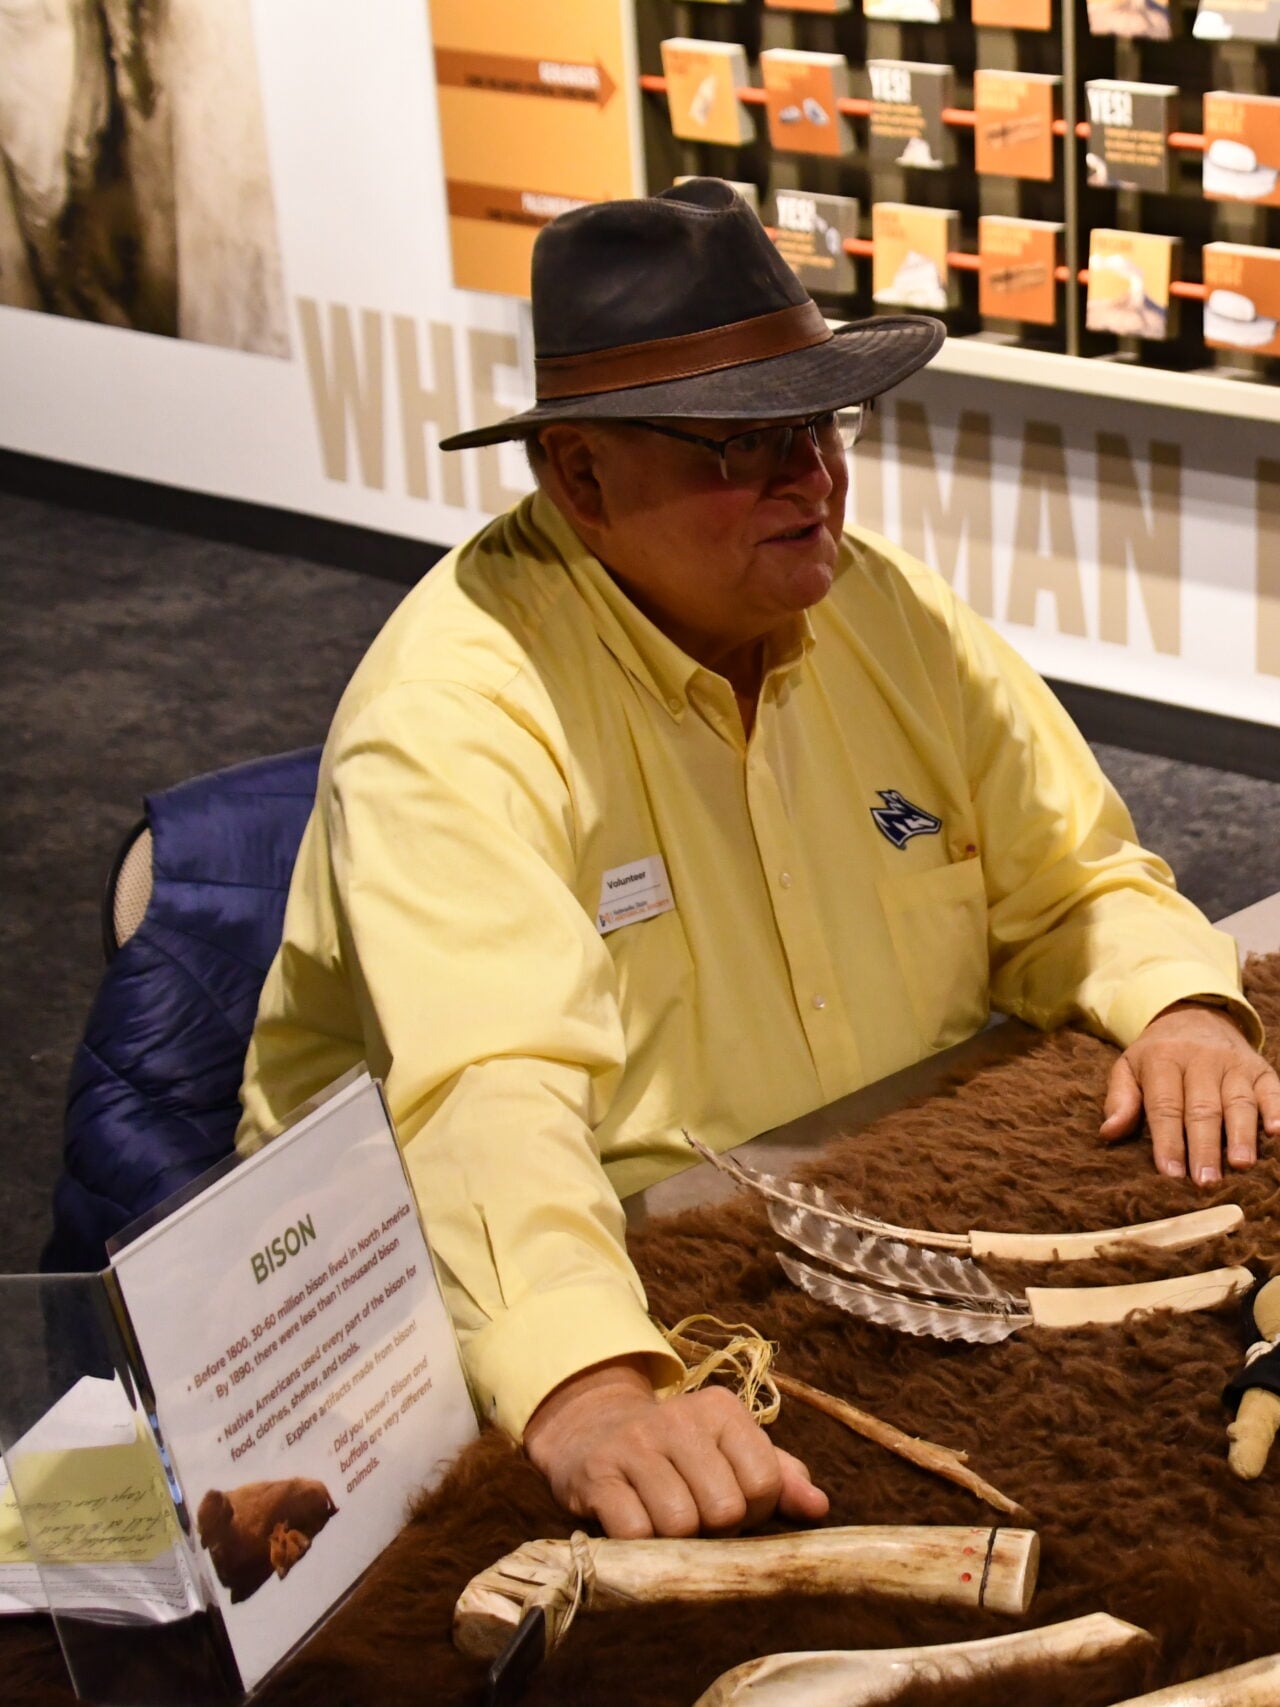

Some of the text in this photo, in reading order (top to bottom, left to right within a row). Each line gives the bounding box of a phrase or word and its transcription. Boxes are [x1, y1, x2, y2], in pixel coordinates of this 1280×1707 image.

[1087, 88, 1133, 127] YES!
[606, 871, 646, 889] Volunteer
[194, 1203, 410, 1388] Before 1800, 30-60 million bison lived in North America
[251, 1213, 316, 1284] BISON
[215, 1382, 229, 1398] By
[229, 1361, 255, 1386] 1890,
[254, 1341, 278, 1366] there
[278, 1321, 300, 1344] were
[299, 1307, 317, 1326] less
[317, 1291, 336, 1312] than
[341, 1252, 378, 1292] thousand
[377, 1237, 400, 1261] bison
[224, 1264, 417, 1439] Native Americans used every part of the bison for
[230, 1342, 361, 1462] food, clothes, shelter, and tools.
[286, 1319, 418, 1447] Explore artifacts made from bison!
[334, 1354, 428, 1453] Did you know? Bison and
[340, 1377, 432, 1473] buffalo are very different
[346, 1457, 380, 1493] animals.
